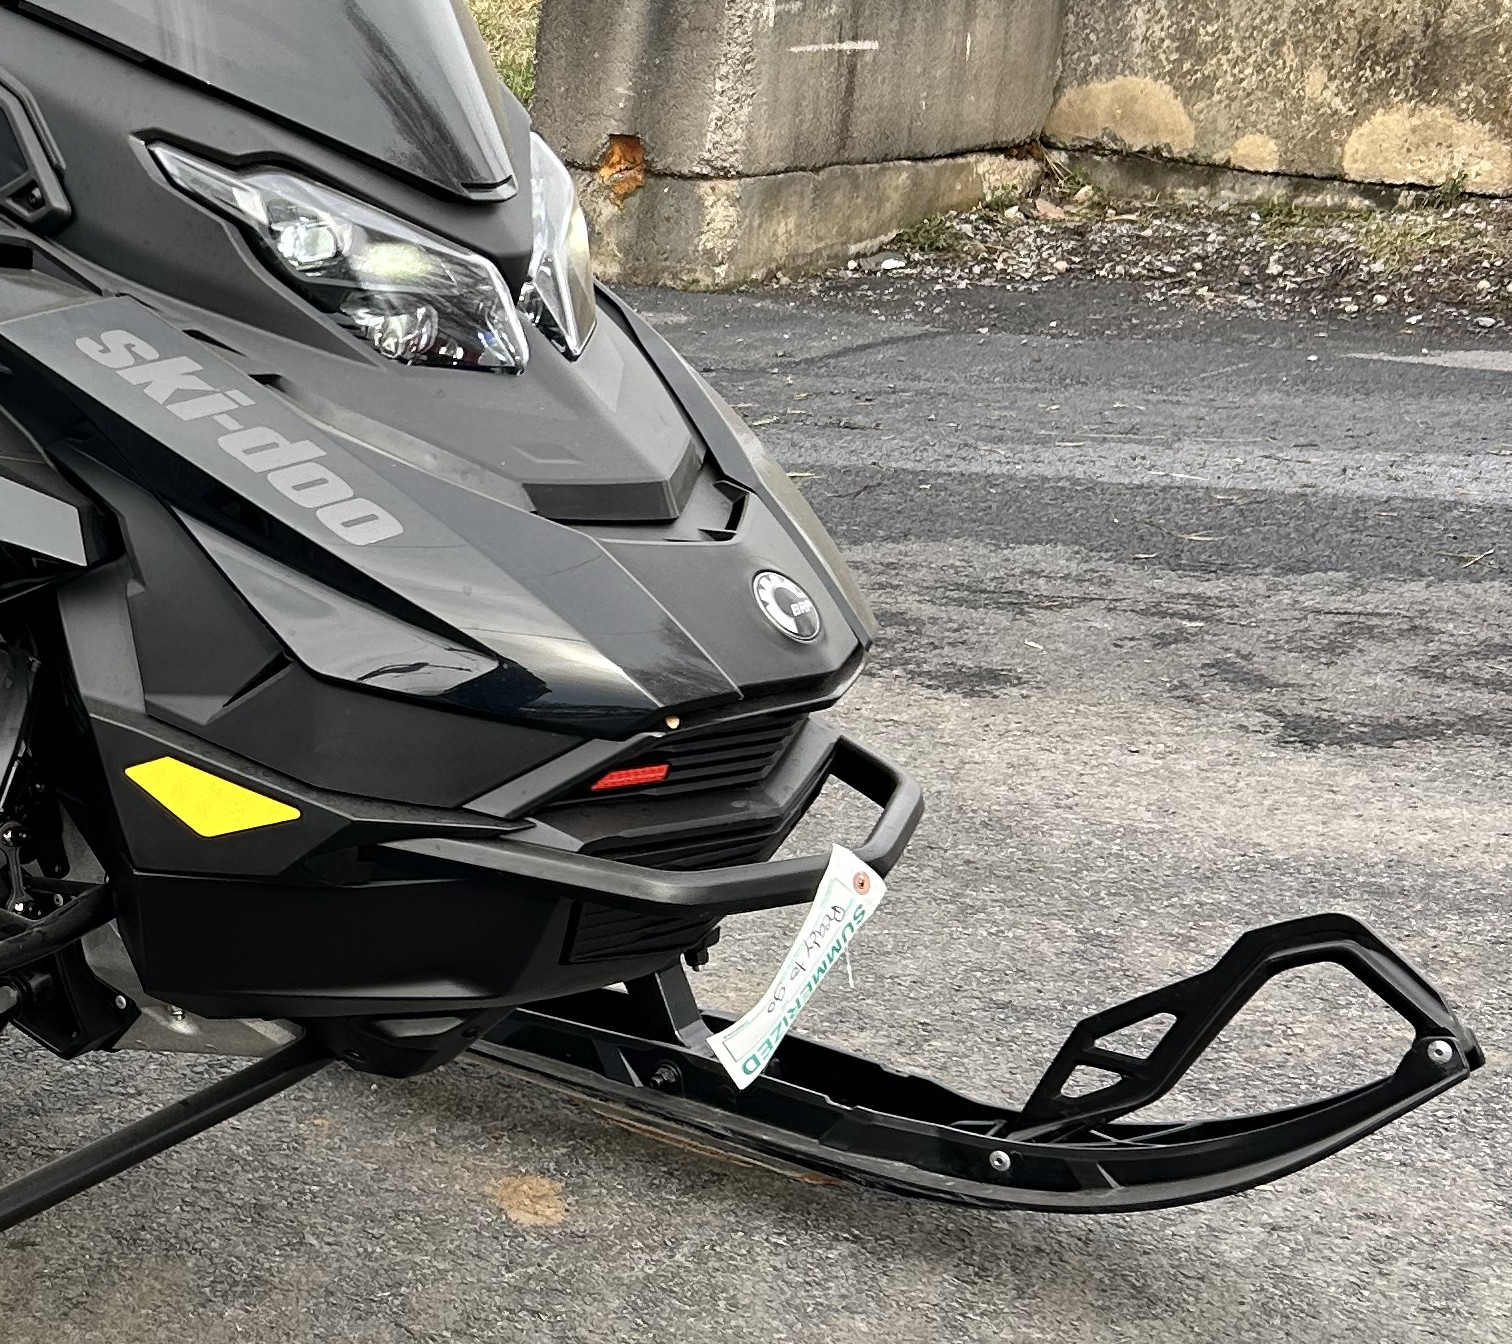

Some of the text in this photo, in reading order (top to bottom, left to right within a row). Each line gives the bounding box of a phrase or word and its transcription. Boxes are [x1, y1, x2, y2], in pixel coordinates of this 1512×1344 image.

[75, 329, 405, 546] ski-doo
[790, 599, 813, 617] BRP
[741, 903, 867, 1076] SUMMERIZED
